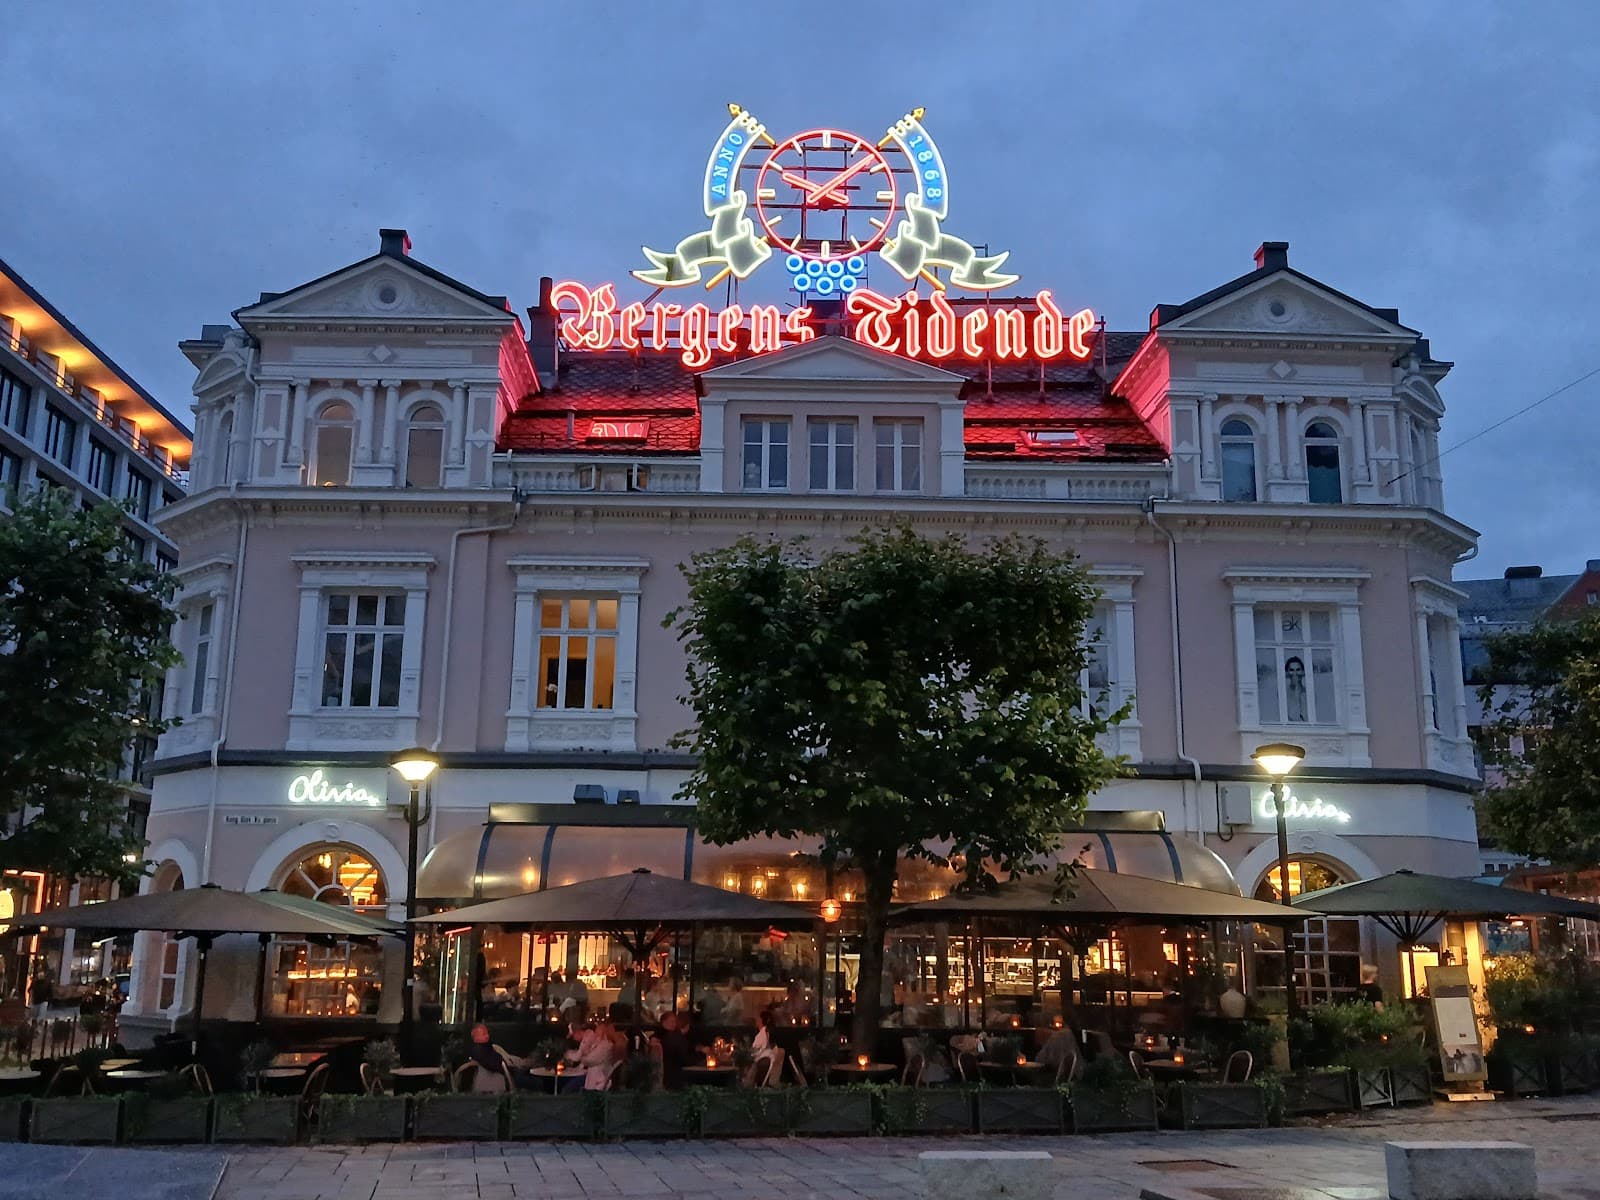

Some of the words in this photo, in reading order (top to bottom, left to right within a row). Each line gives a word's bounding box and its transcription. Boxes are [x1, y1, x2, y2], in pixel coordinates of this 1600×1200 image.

[711, 133, 743, 197] ANNO
[908, 135, 942, 198] 1868
[550, 281, 815, 368] Bergens
[847, 288, 1095, 359] Tidende
[287, 768, 380, 807] Olivia
